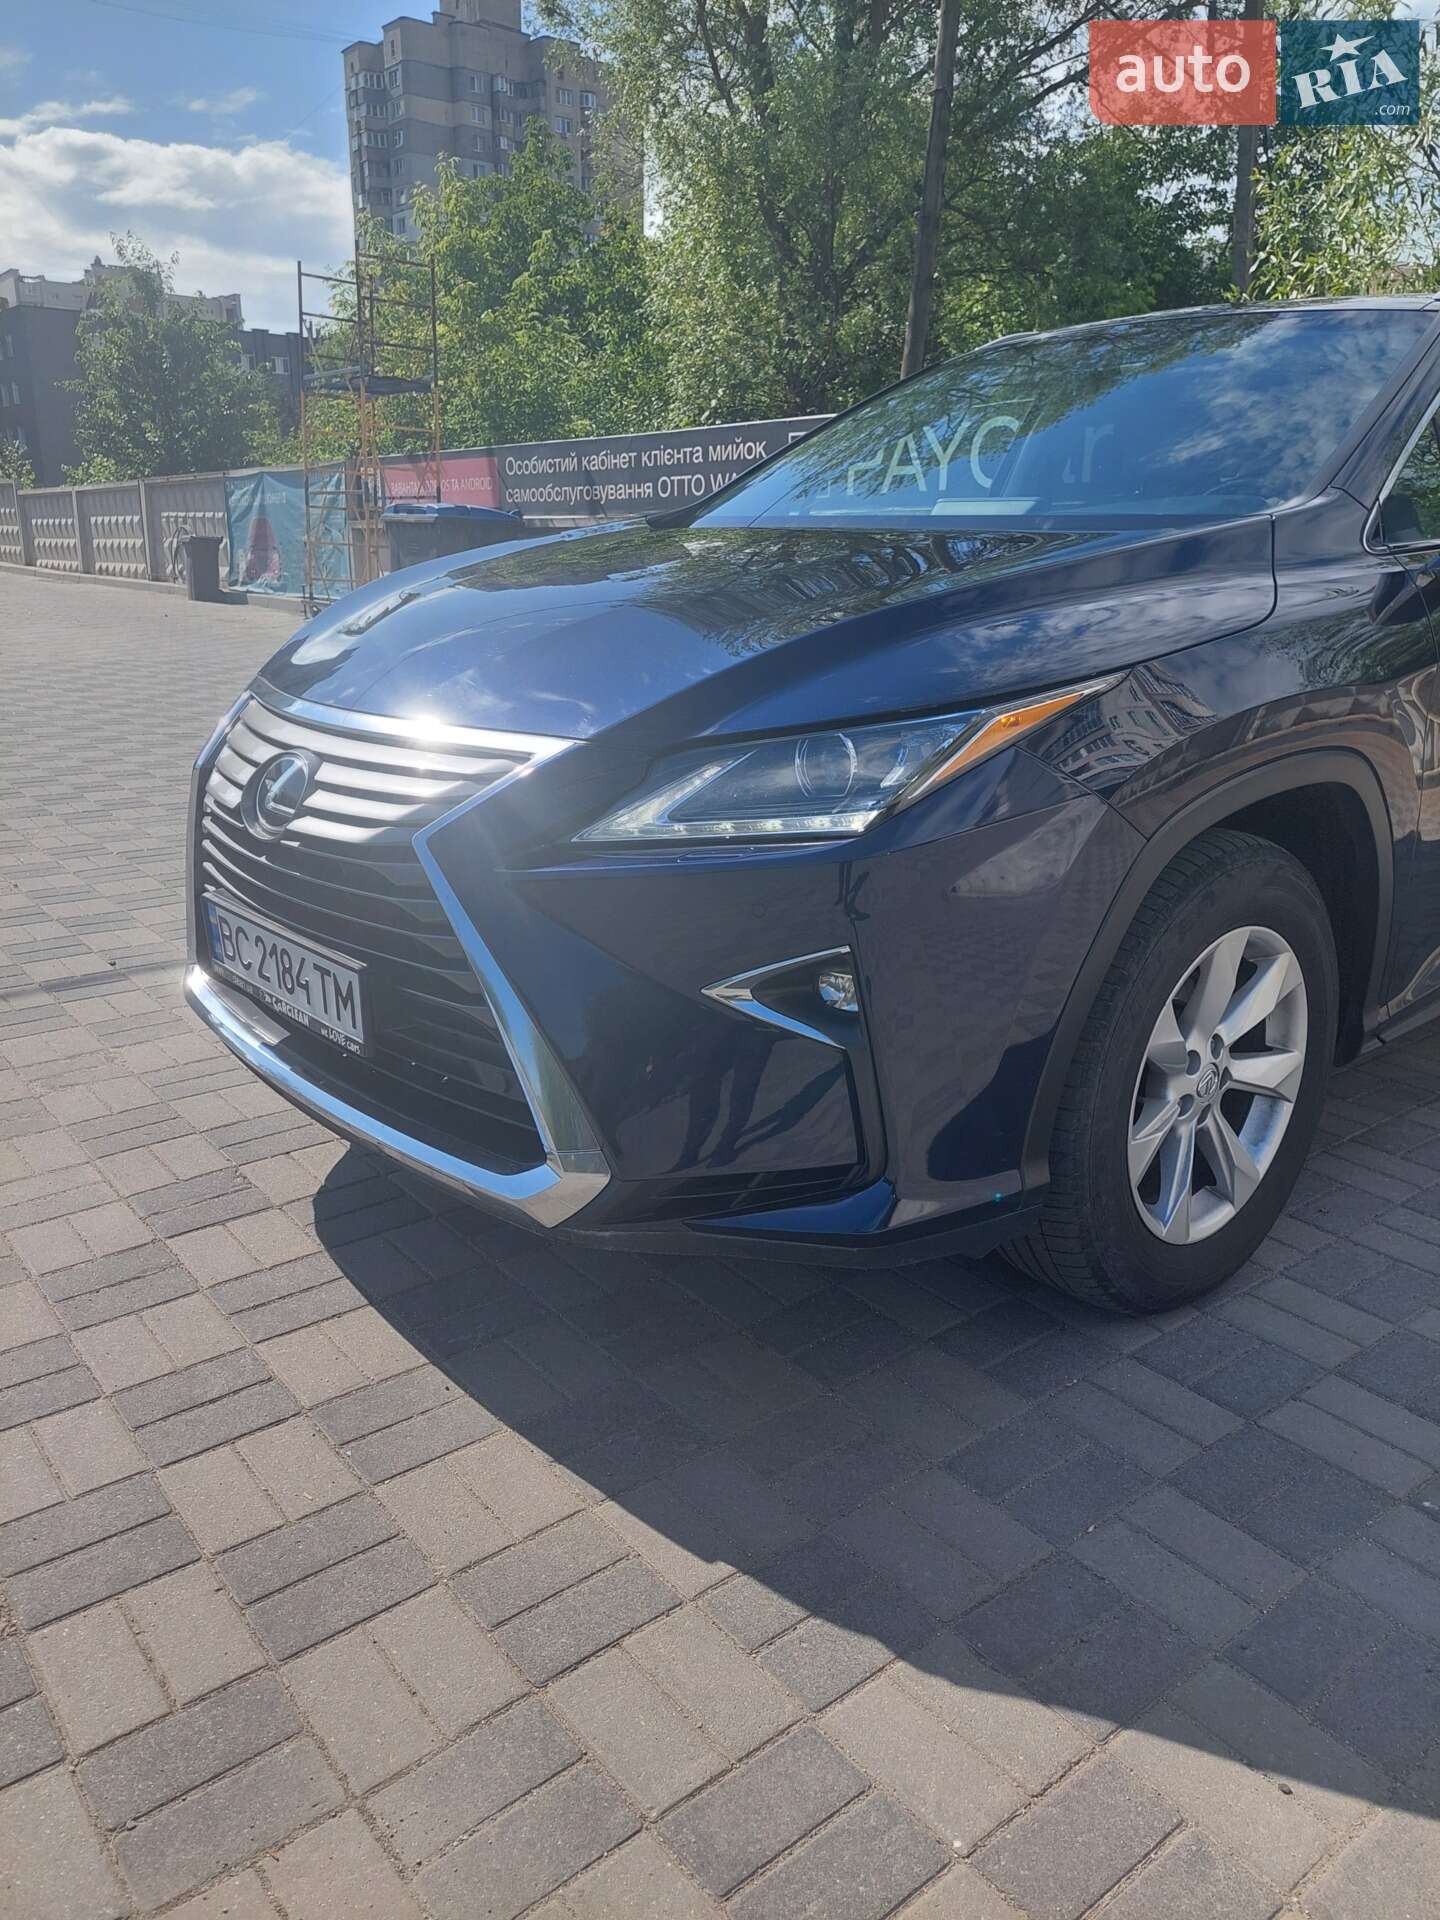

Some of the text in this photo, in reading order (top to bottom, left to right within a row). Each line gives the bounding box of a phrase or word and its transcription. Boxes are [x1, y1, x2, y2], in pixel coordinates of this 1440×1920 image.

[505, 437, 768, 475] Особистий кабінет клієнта мийок
[505, 483, 653, 505] самообслуговування
